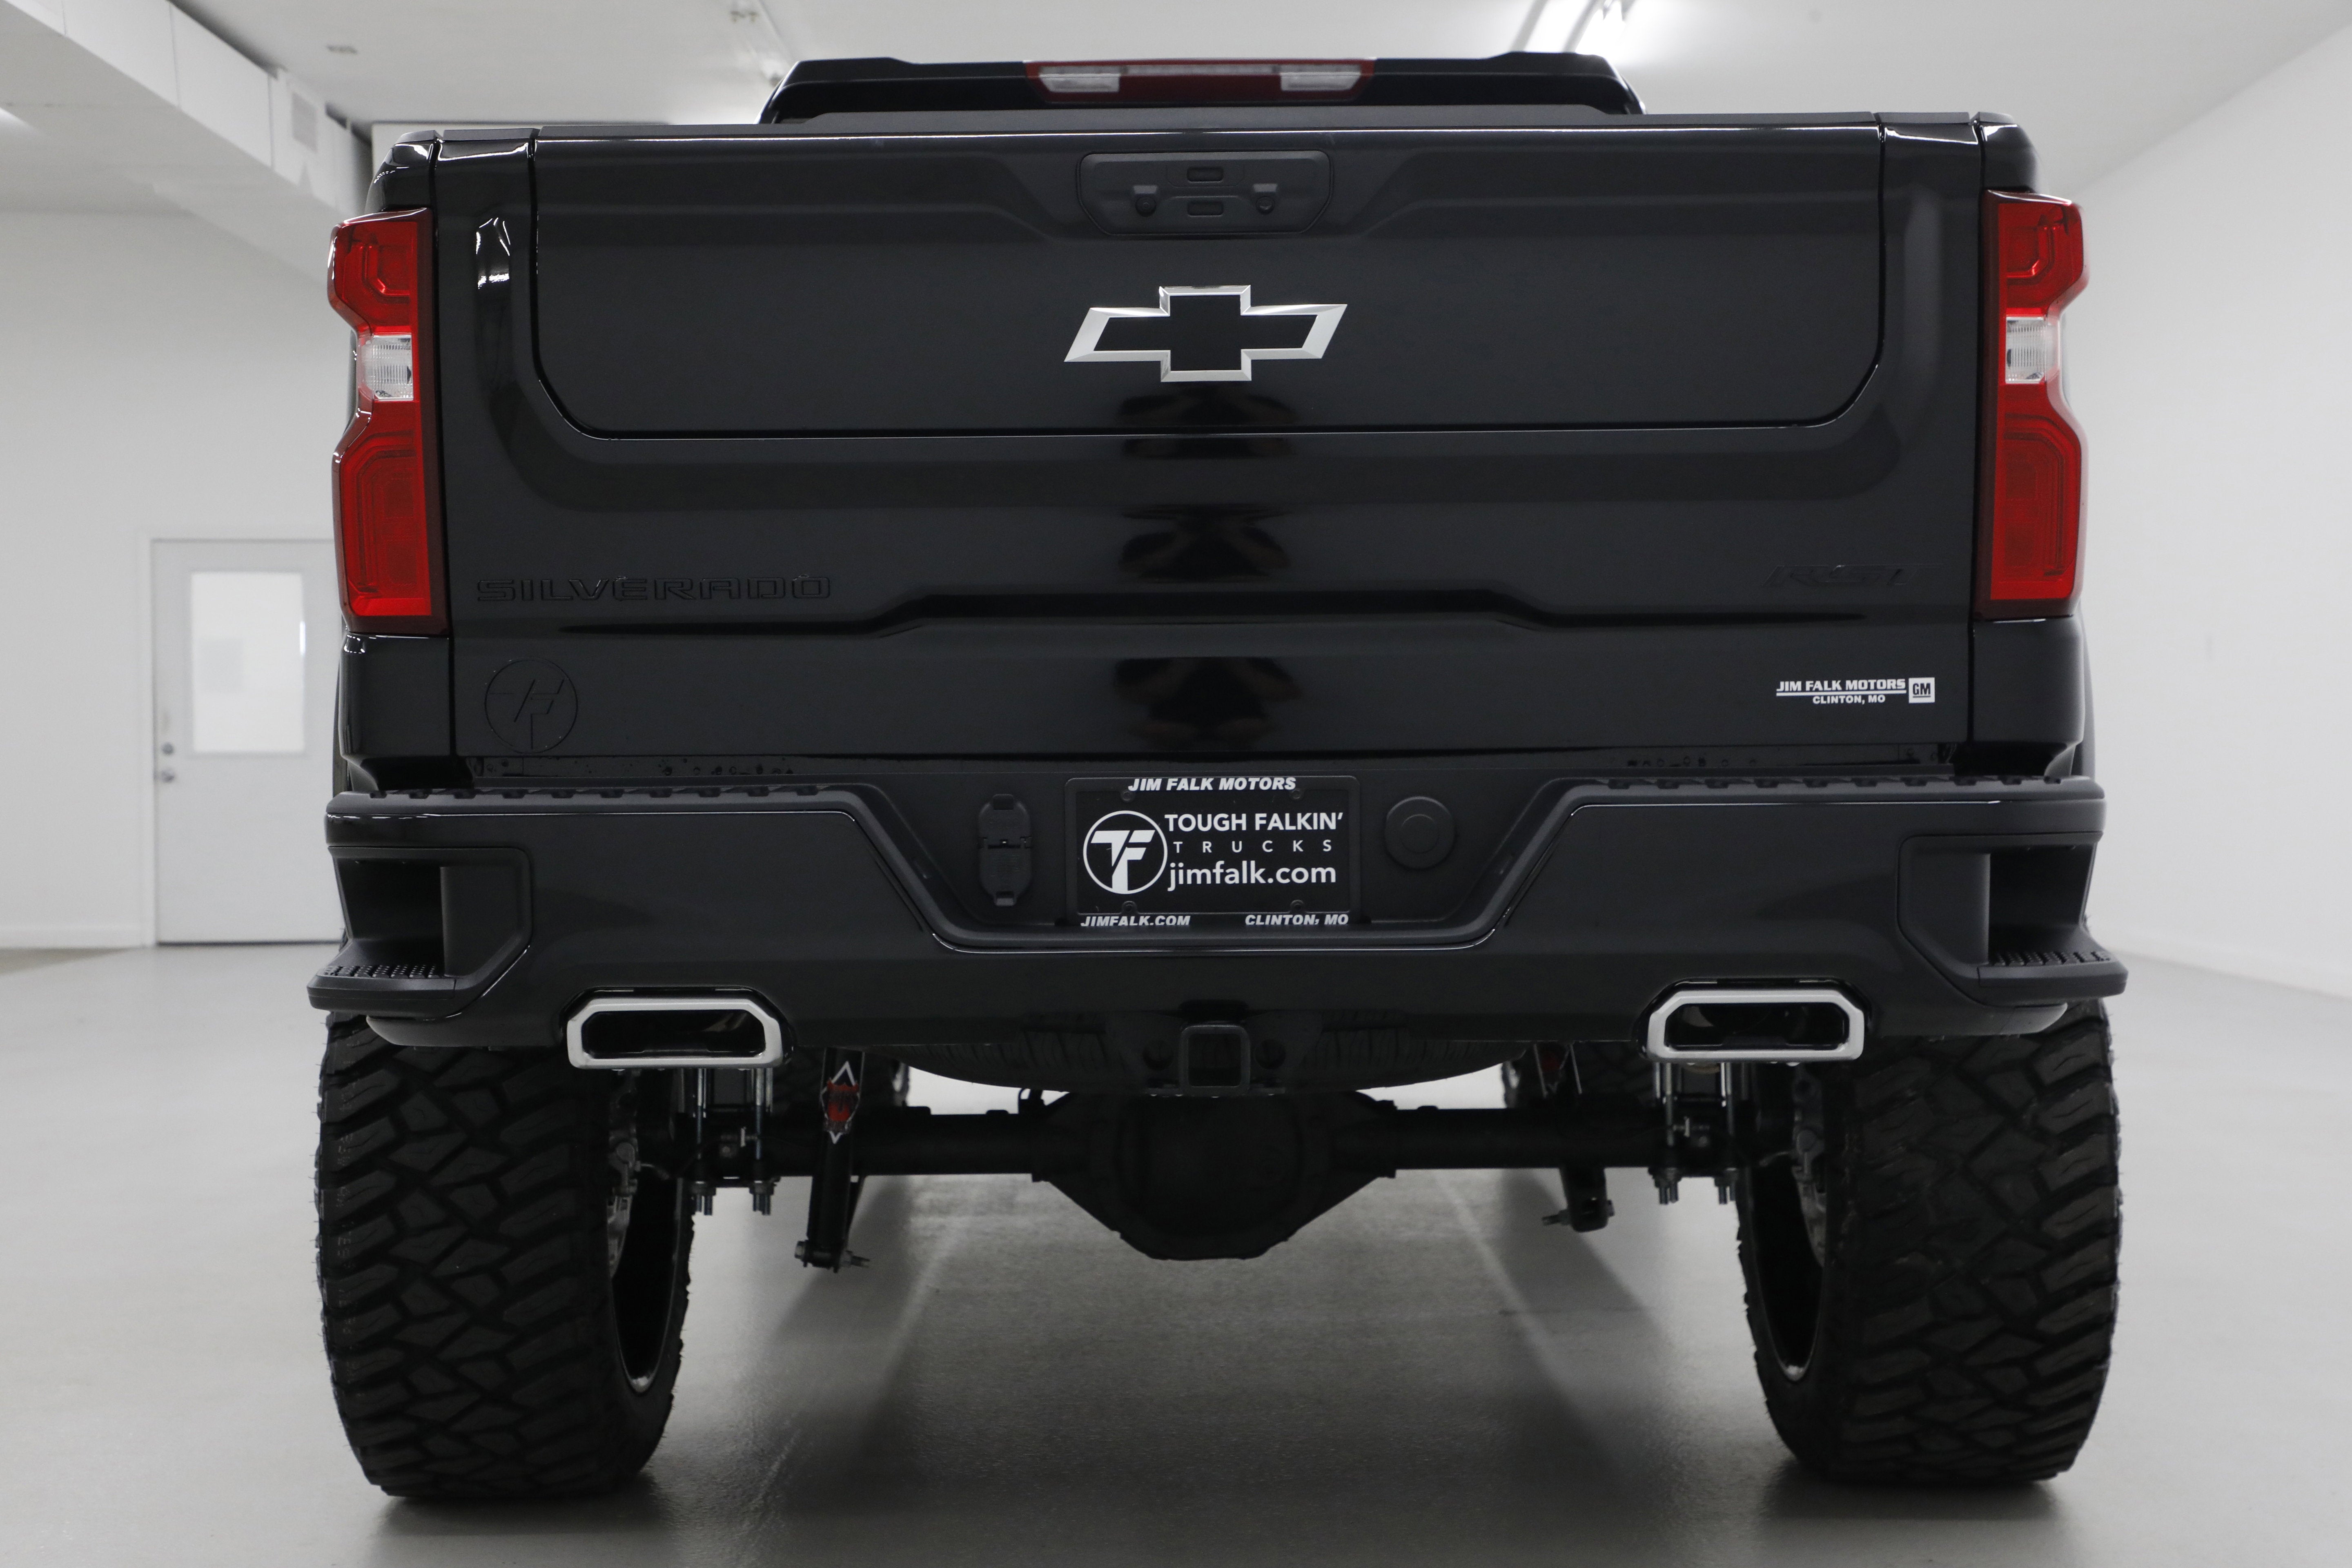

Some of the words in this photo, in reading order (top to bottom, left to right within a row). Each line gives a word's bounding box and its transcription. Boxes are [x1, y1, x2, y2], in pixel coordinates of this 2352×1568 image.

[477, 575, 831, 602] SILVERADO
[1776, 681, 1802, 692] JIM
[1805, 680, 1842, 691] FALK
[1845, 679, 1906, 690] MOTORS
[1912, 683, 1931, 695] GM
[1812, 695, 1865, 705] CLINTON,
[1868, 695, 1886, 704] MO
[1128, 777, 1161, 791] JIM
[1166, 777, 1214, 791] FALK
[1218, 776, 1297, 791] MOTORS
[1164, 813, 1247, 832] TOUGH
[1173, 839, 1332, 853] TRUCKS
[1167, 860, 1336, 891] jimfalk.com
[1080, 915, 1191, 927] JIMFALK.COM
[1245, 914, 1320, 926] CLINTON,
[1324, 914, 1349, 925] MO
